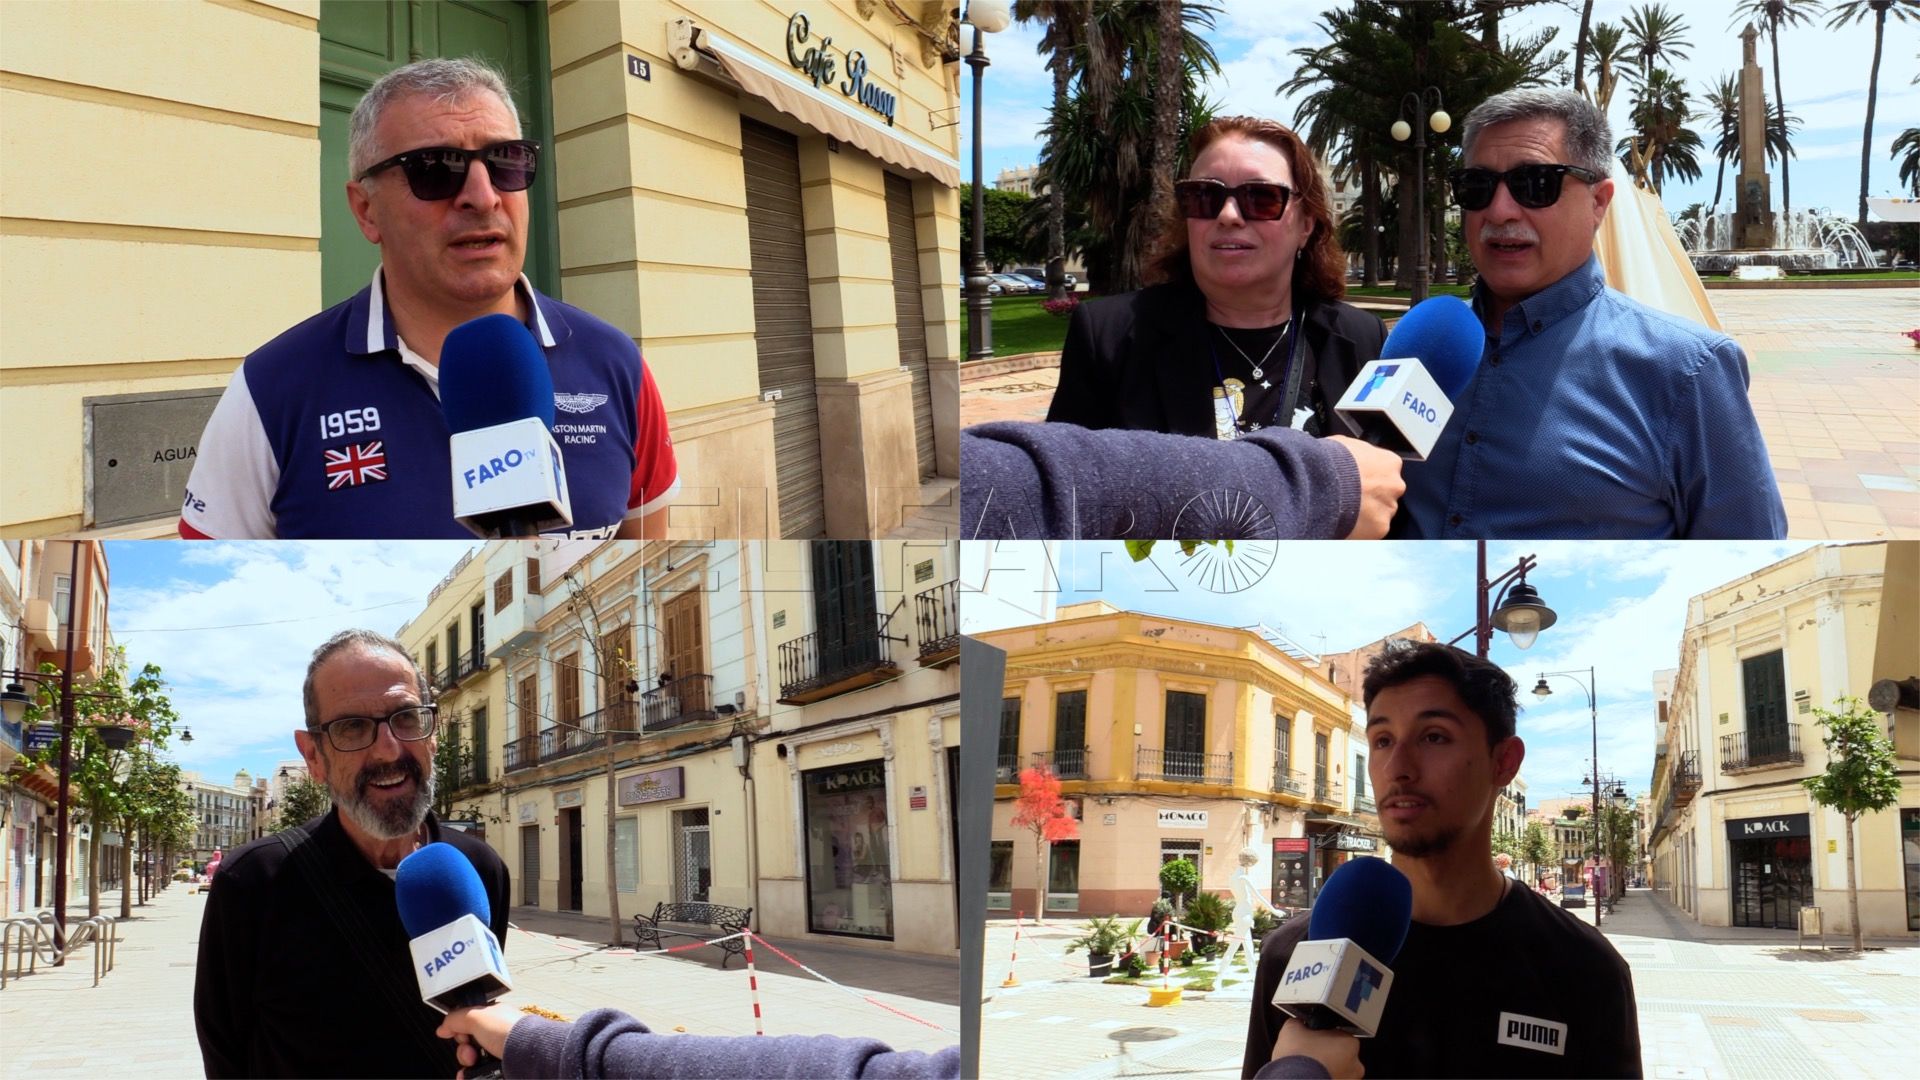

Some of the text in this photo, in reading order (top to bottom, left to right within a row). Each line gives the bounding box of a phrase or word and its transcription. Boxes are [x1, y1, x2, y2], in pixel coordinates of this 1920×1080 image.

[786, 10, 837, 89] Café
[632, 59, 648, 78] 15
[1402, 391, 1437, 424] FARO
[320, 406, 382, 440] 1959
[578, 424, 607, 434] MARTIN
[564, 434, 595, 444] RACING
[153, 446, 198, 464] AGUA
[463, 448, 537, 490] FARO TV
[1158, 810, 1207, 823] MONACO
[1744, 819, 1790, 835] KRACK
[423, 937, 476, 978] FARO TV
[1285, 961, 1323, 986] FARO
[1506, 1019, 1560, 1047] PUMA
